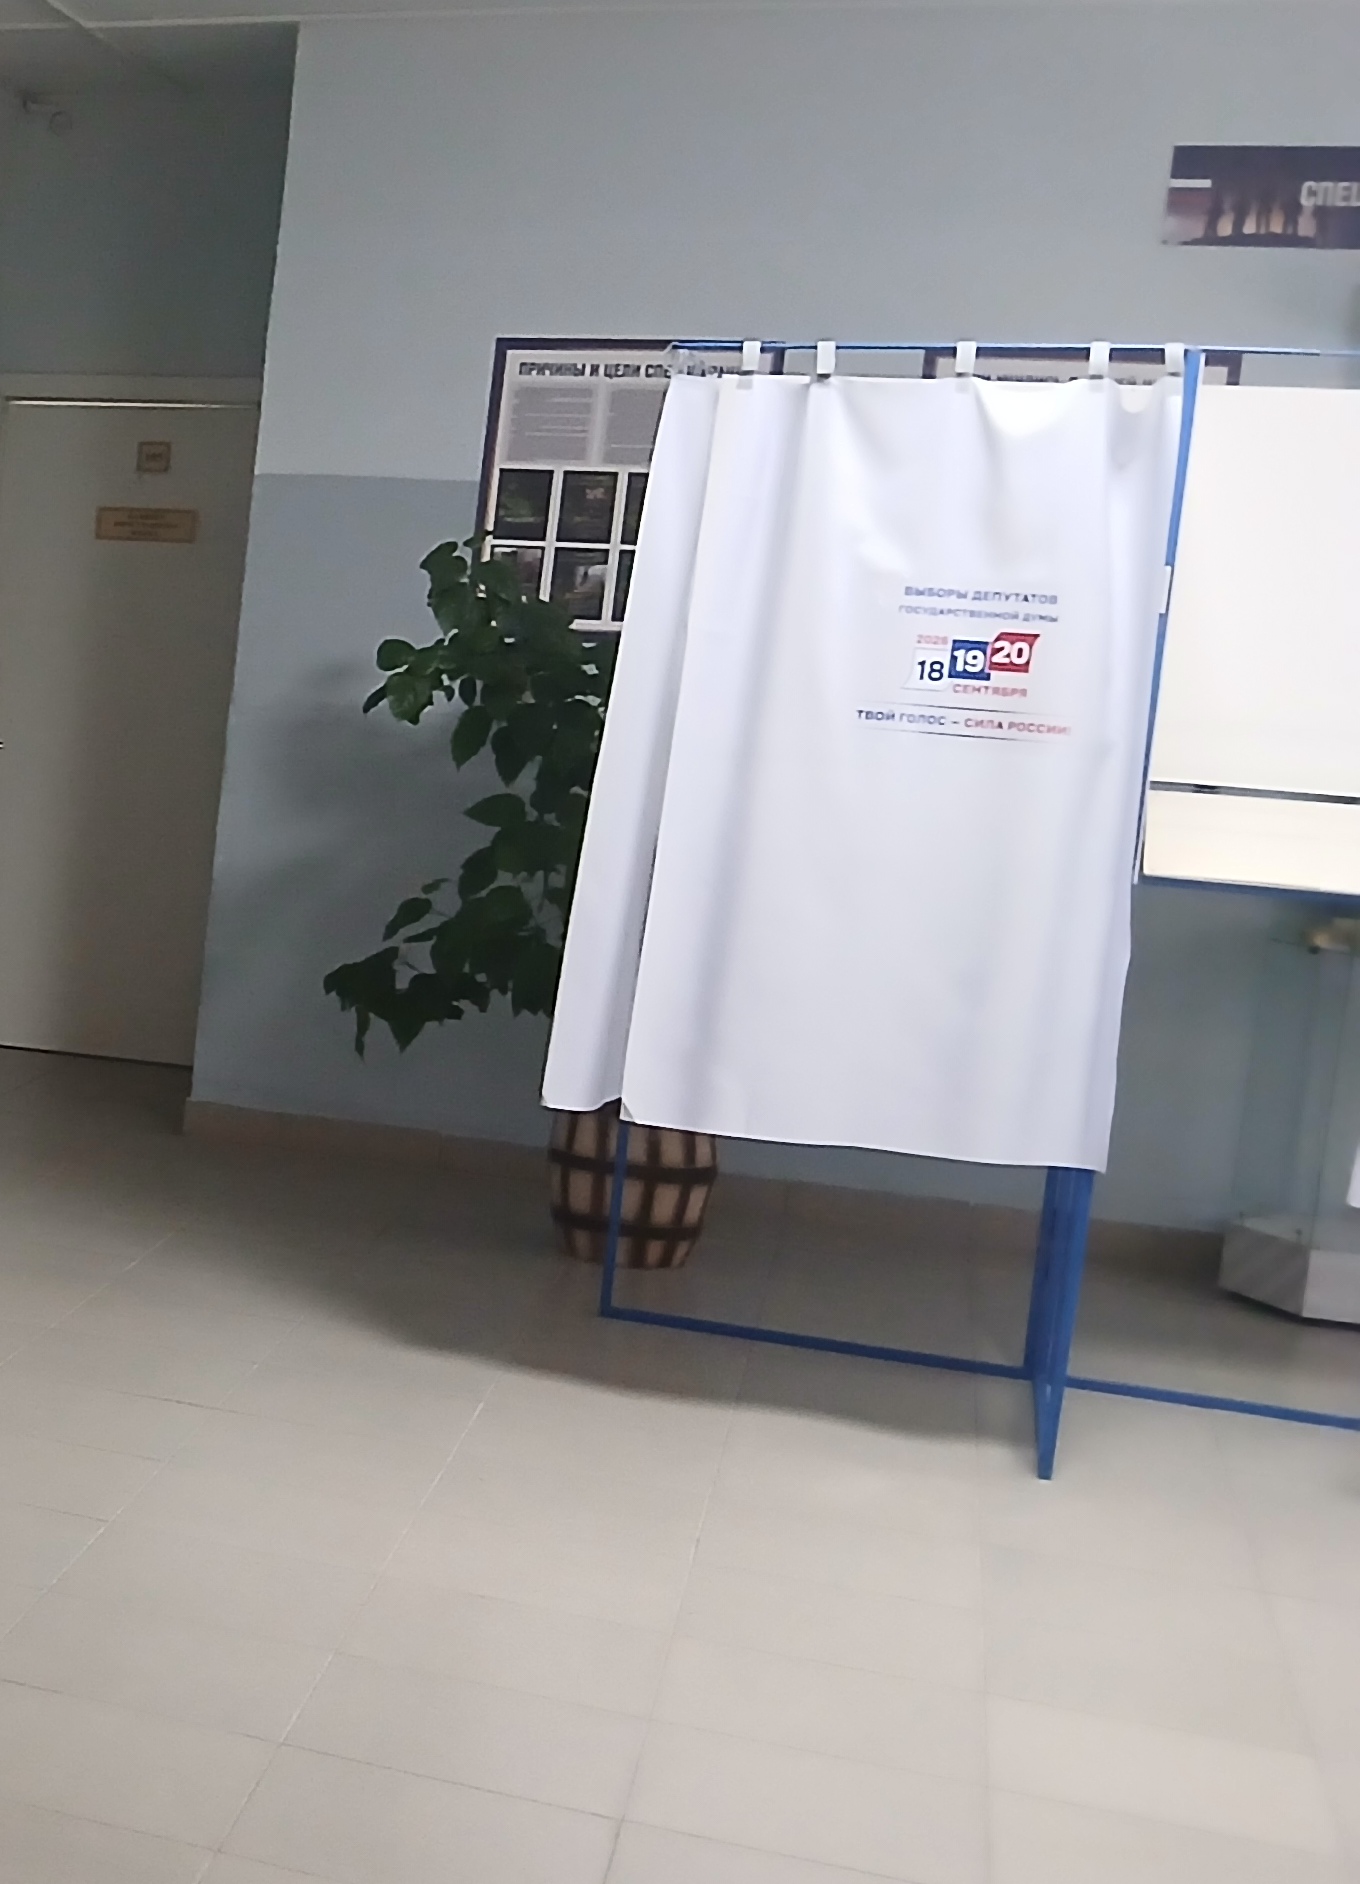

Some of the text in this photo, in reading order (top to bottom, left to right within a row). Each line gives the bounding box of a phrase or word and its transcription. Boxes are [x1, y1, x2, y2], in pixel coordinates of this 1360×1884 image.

[519, 362, 586, 376] ПРИЧИНЫ
[590, 364, 600, 376] И
[604, 364, 641, 379] ЦЕЛИ
[904, 586, 1058, 605] ВЫБОРЫ ДЕПУТАТОВ
[899, 605, 1058, 623] ГОСУДАРСТВЕННОЙ ДУМЫ
[917, 641, 1030, 682] 18 19 20
[953, 683, 1027, 697] СЕНТЯБРЯ
[856, 709, 896, 722] ТВОЙ
[899, 714, 946, 726] ГОЛОС
[964, 718, 1003, 730] СИЛА
